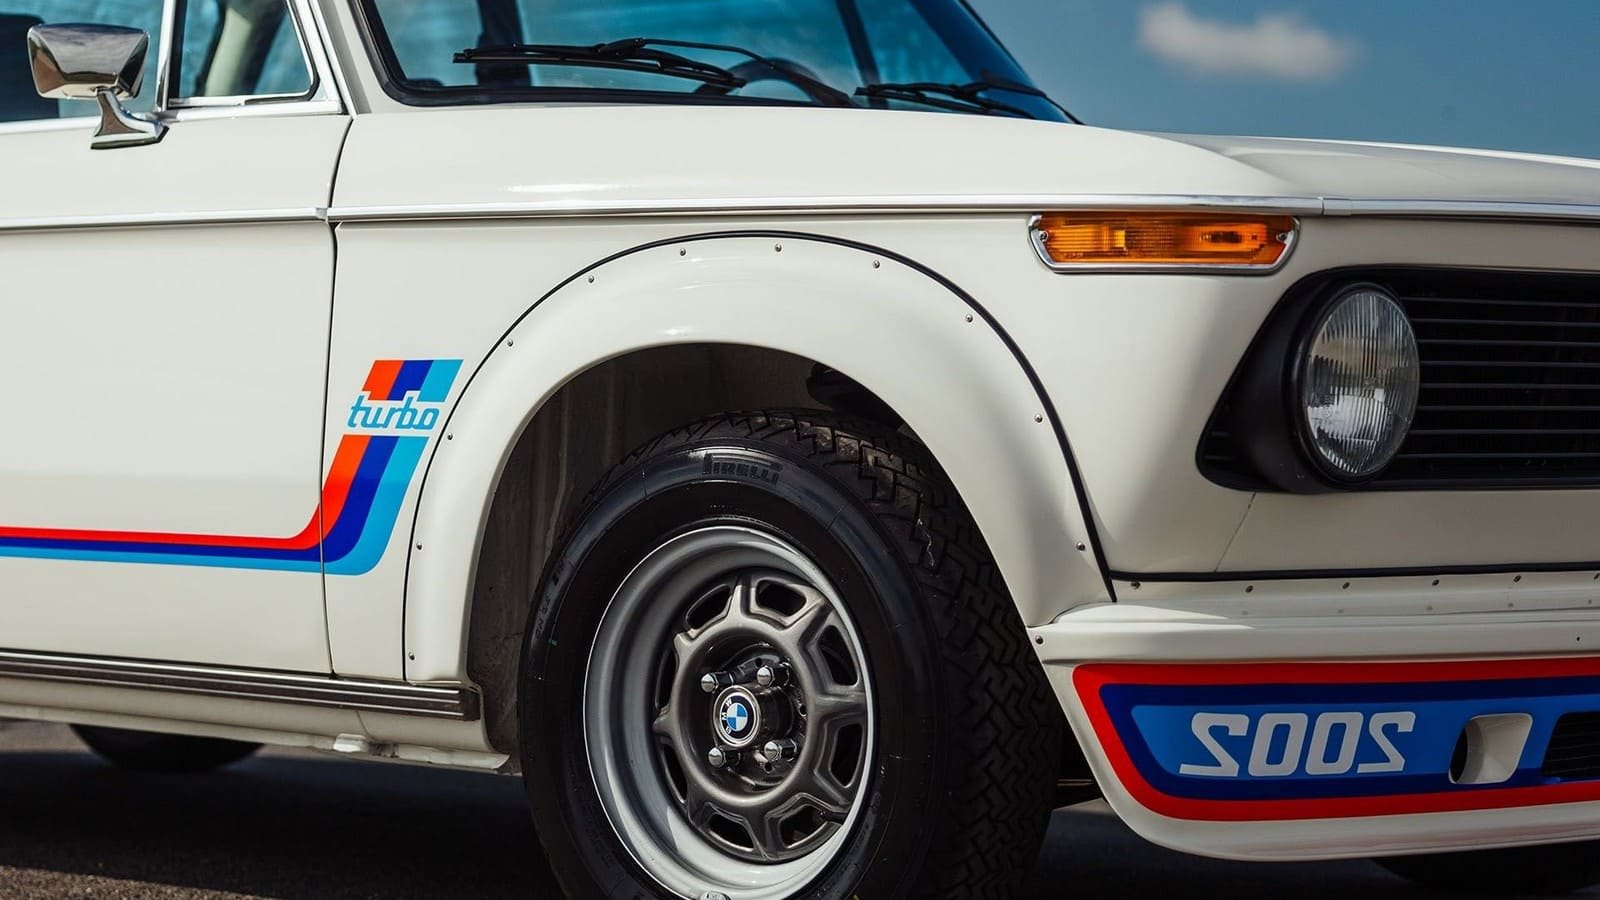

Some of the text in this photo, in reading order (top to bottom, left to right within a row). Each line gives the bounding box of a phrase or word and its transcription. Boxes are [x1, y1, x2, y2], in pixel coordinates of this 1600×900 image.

[347, 395, 440, 430] turbo
[702, 453, 783, 485] PIRELLI
[721, 697, 733, 735] BMW
